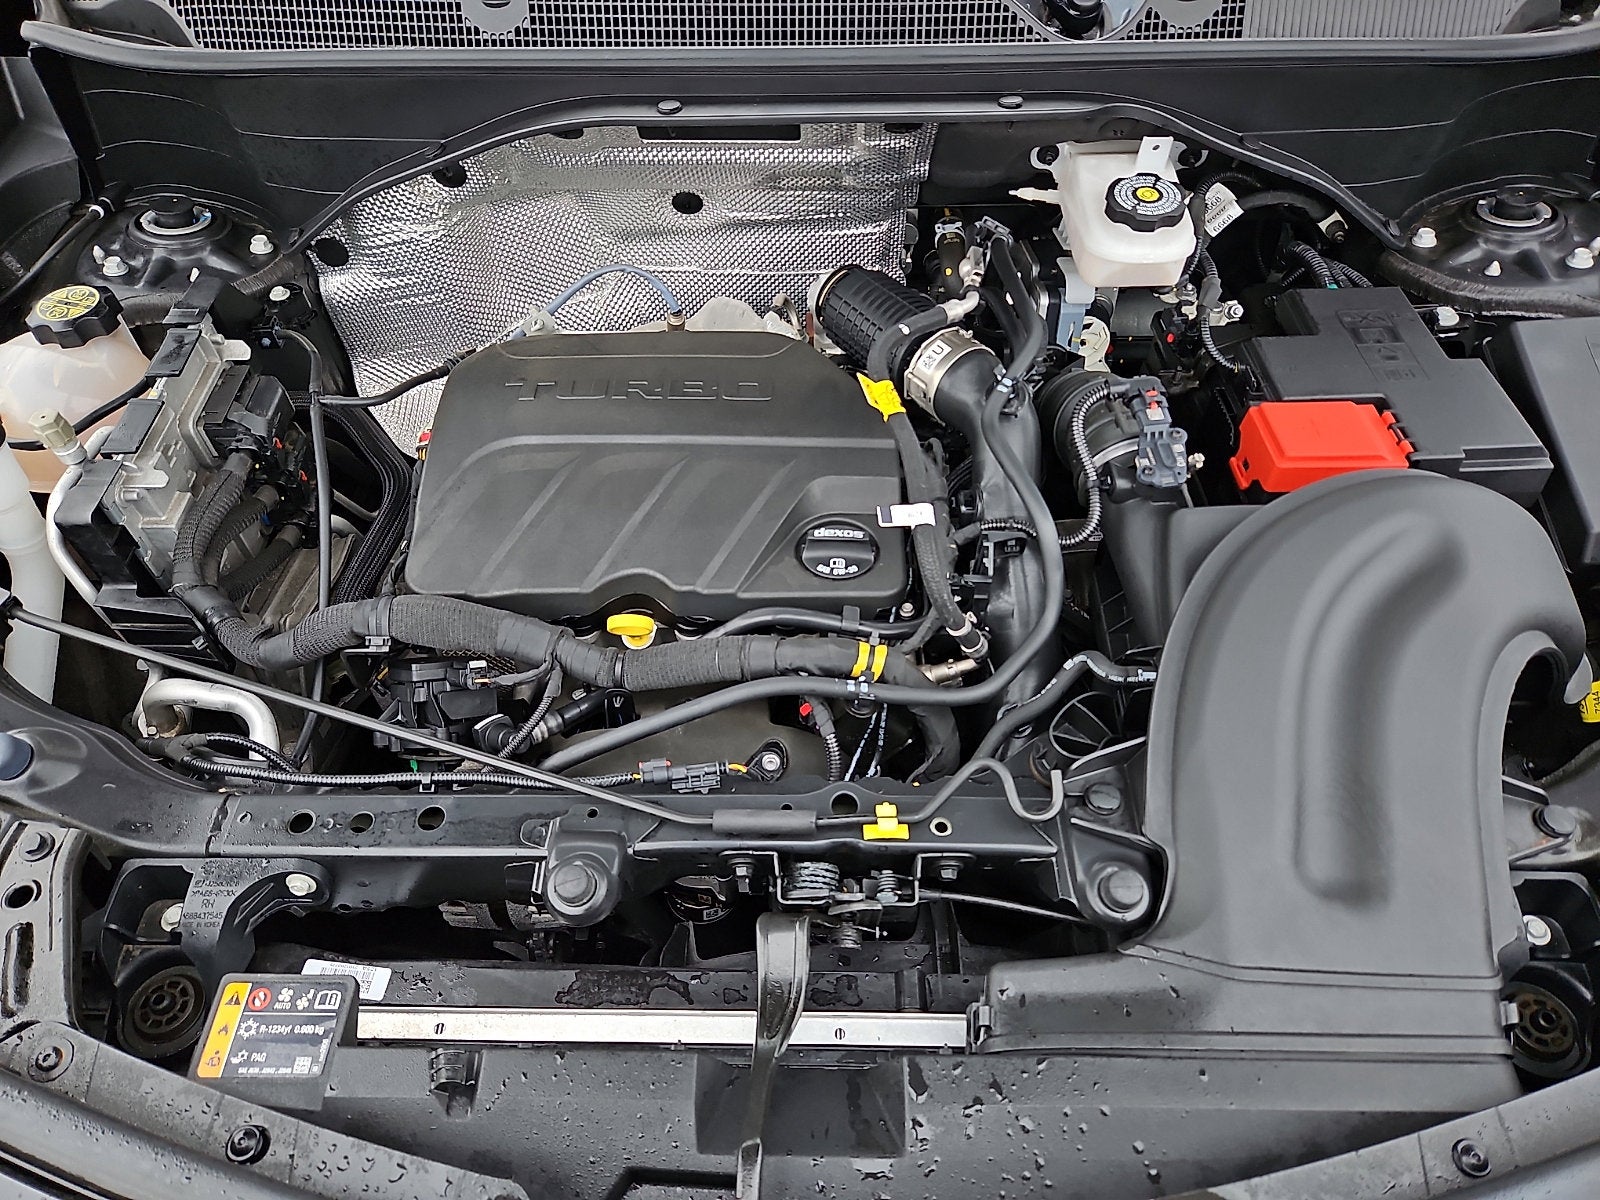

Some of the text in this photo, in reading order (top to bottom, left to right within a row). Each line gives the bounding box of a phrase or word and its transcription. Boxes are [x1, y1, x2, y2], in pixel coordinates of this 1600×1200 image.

[504, 379, 774, 402] TURBO
[813, 527, 866, 539] dexos
[274, 1002, 292, 1010] AUTO
[259, 1024, 292, 1035] R-1234yf
[315, 1025, 325, 1035] kg
[250, 1052, 267, 1062] PAG
